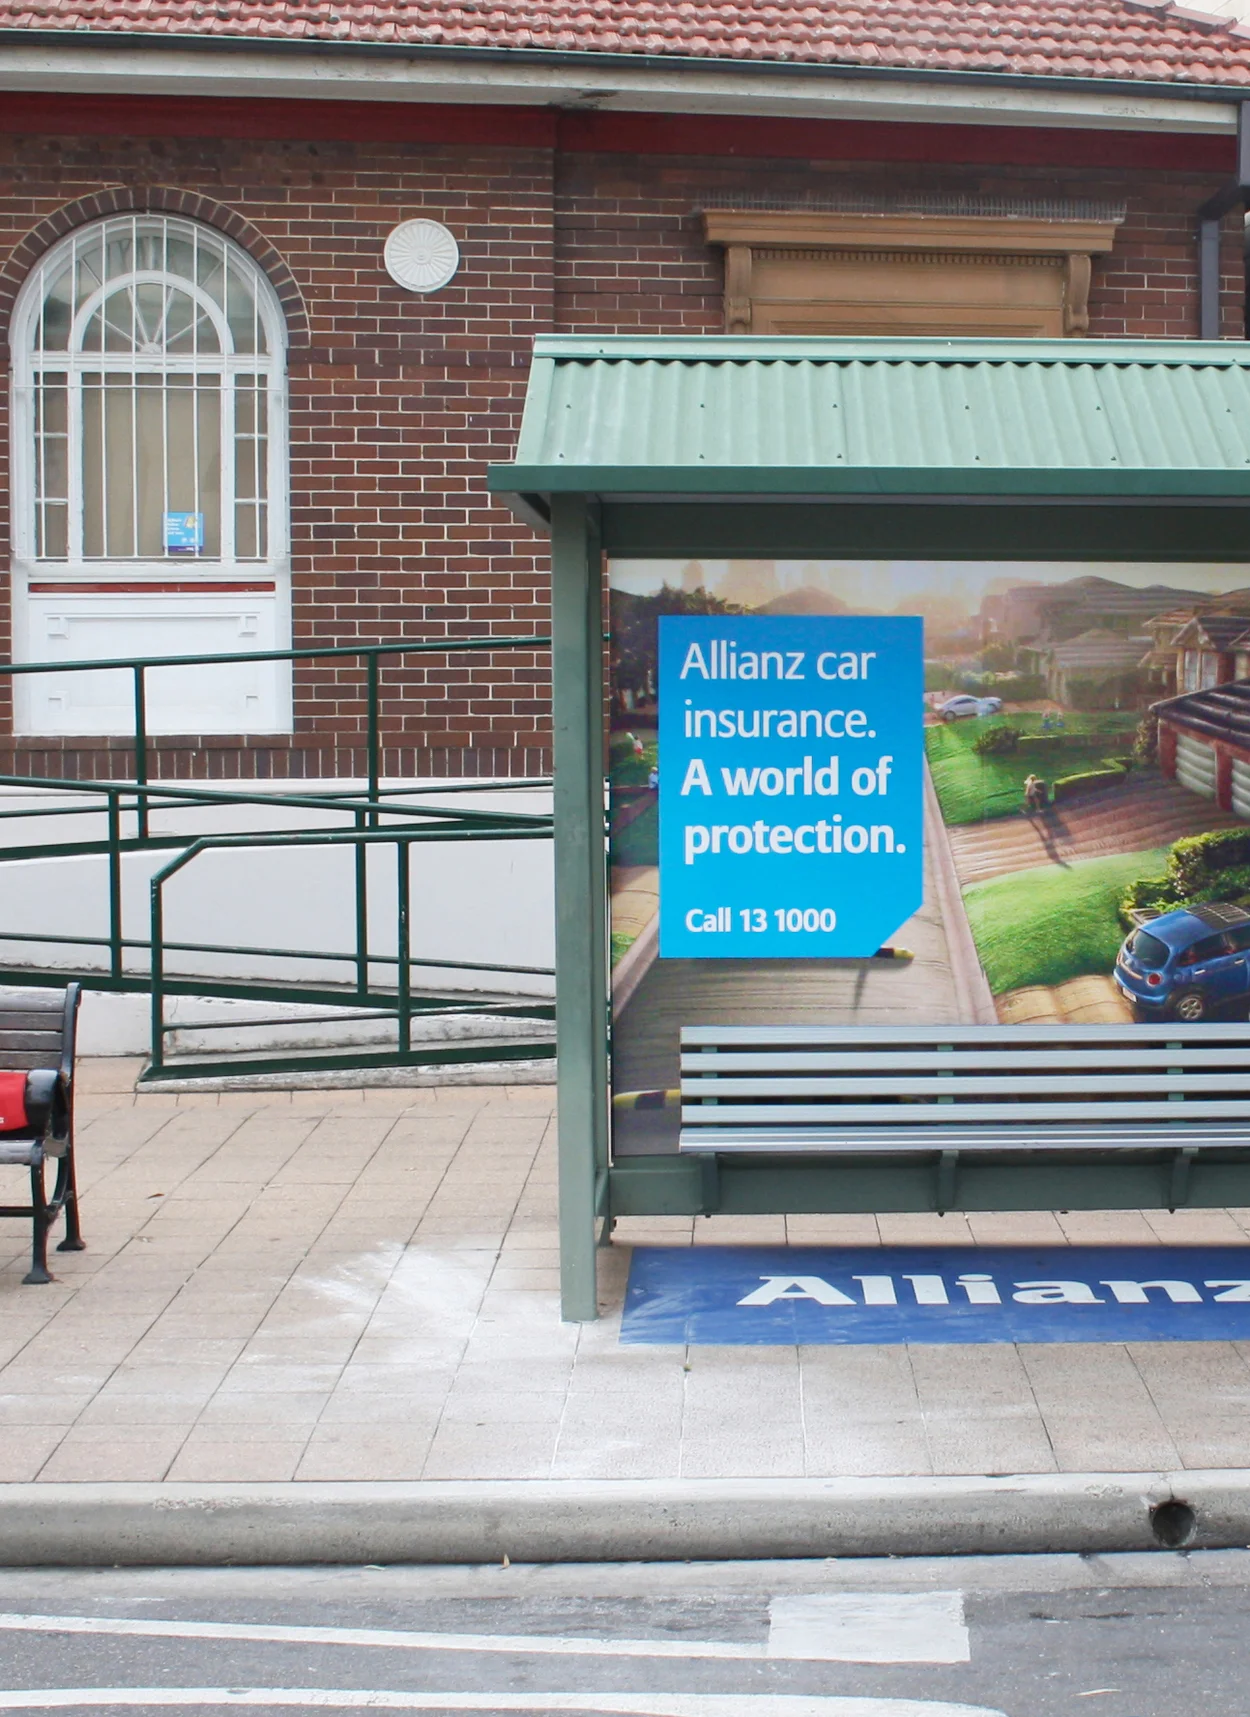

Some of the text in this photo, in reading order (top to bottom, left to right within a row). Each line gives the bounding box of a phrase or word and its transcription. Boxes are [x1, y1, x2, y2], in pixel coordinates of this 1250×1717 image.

[680, 640, 876, 680] Allianz car
[684, 699, 876, 738] insurance.
[680, 755, 893, 796] A world of
[684, 814, 906, 865] protection.
[685, 907, 836, 933] Call 13 1000
